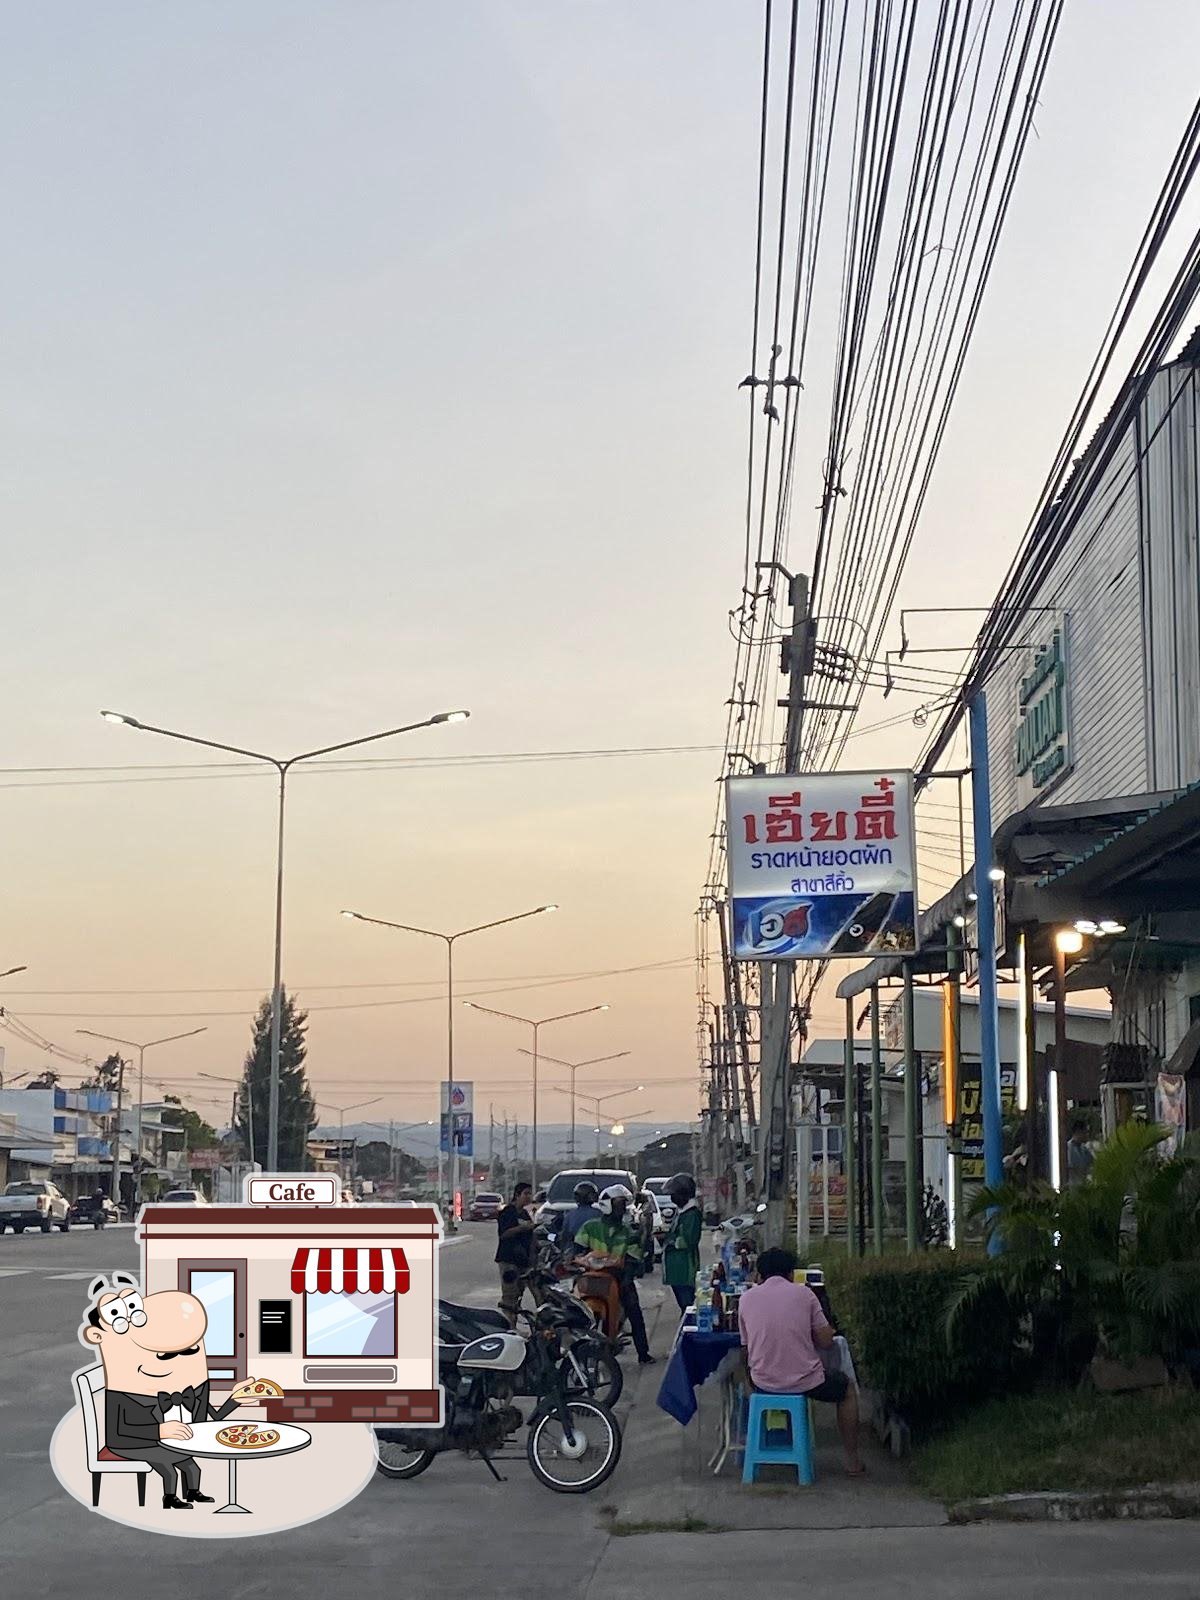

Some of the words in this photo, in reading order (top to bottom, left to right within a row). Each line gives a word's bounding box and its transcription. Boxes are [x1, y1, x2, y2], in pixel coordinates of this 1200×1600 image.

[742, 777, 899, 844] เฮียตี๋
[751, 844, 892, 869] ราดหน้ายอดผัก
[791, 870, 855, 894] สาขาสีคิ้ว
